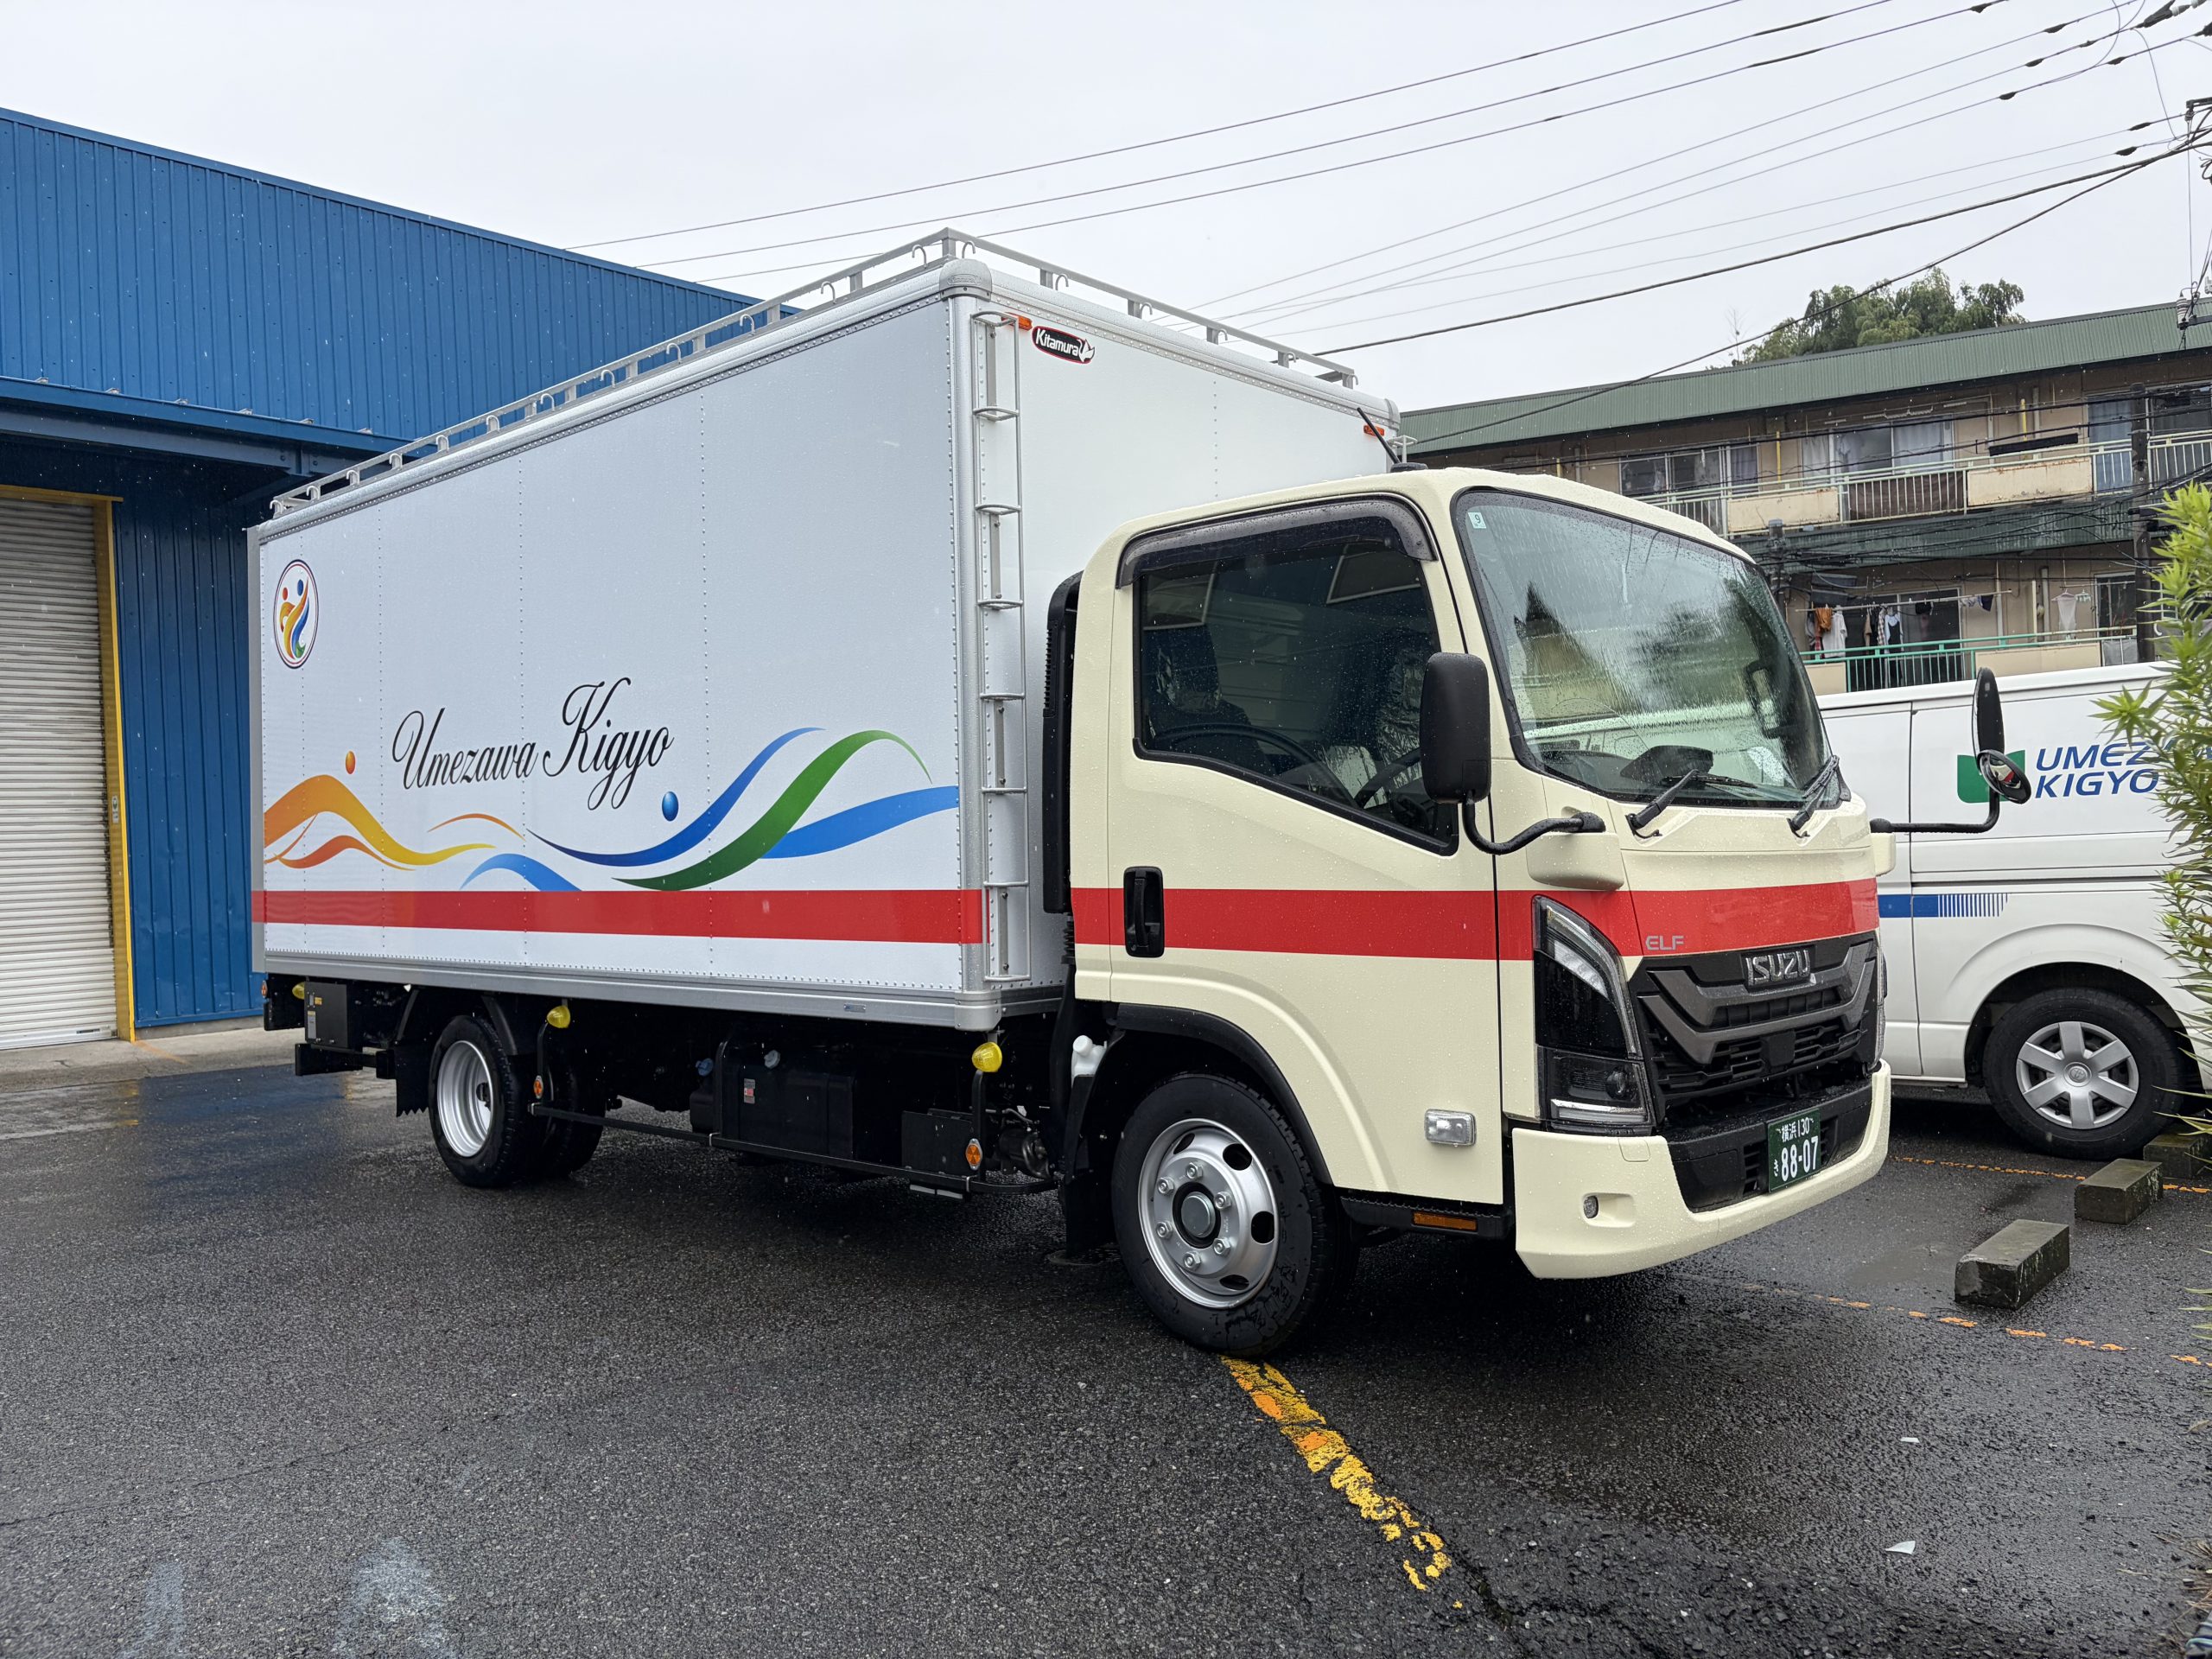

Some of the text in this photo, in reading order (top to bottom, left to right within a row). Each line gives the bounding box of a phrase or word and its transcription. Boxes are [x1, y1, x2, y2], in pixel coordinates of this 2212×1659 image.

[1036, 328, 1078, 356] Kitamura
[392, 677, 674, 810] Umezawa Kigyo
[2036, 739, 2212, 772] UMEZ
[2035, 768, 2159, 798] KIGYO
[1645, 935, 1684, 950] ELF
[1745, 950, 1811, 987] ISUZU
[1781, 1135, 1819, 1182] 88-07
